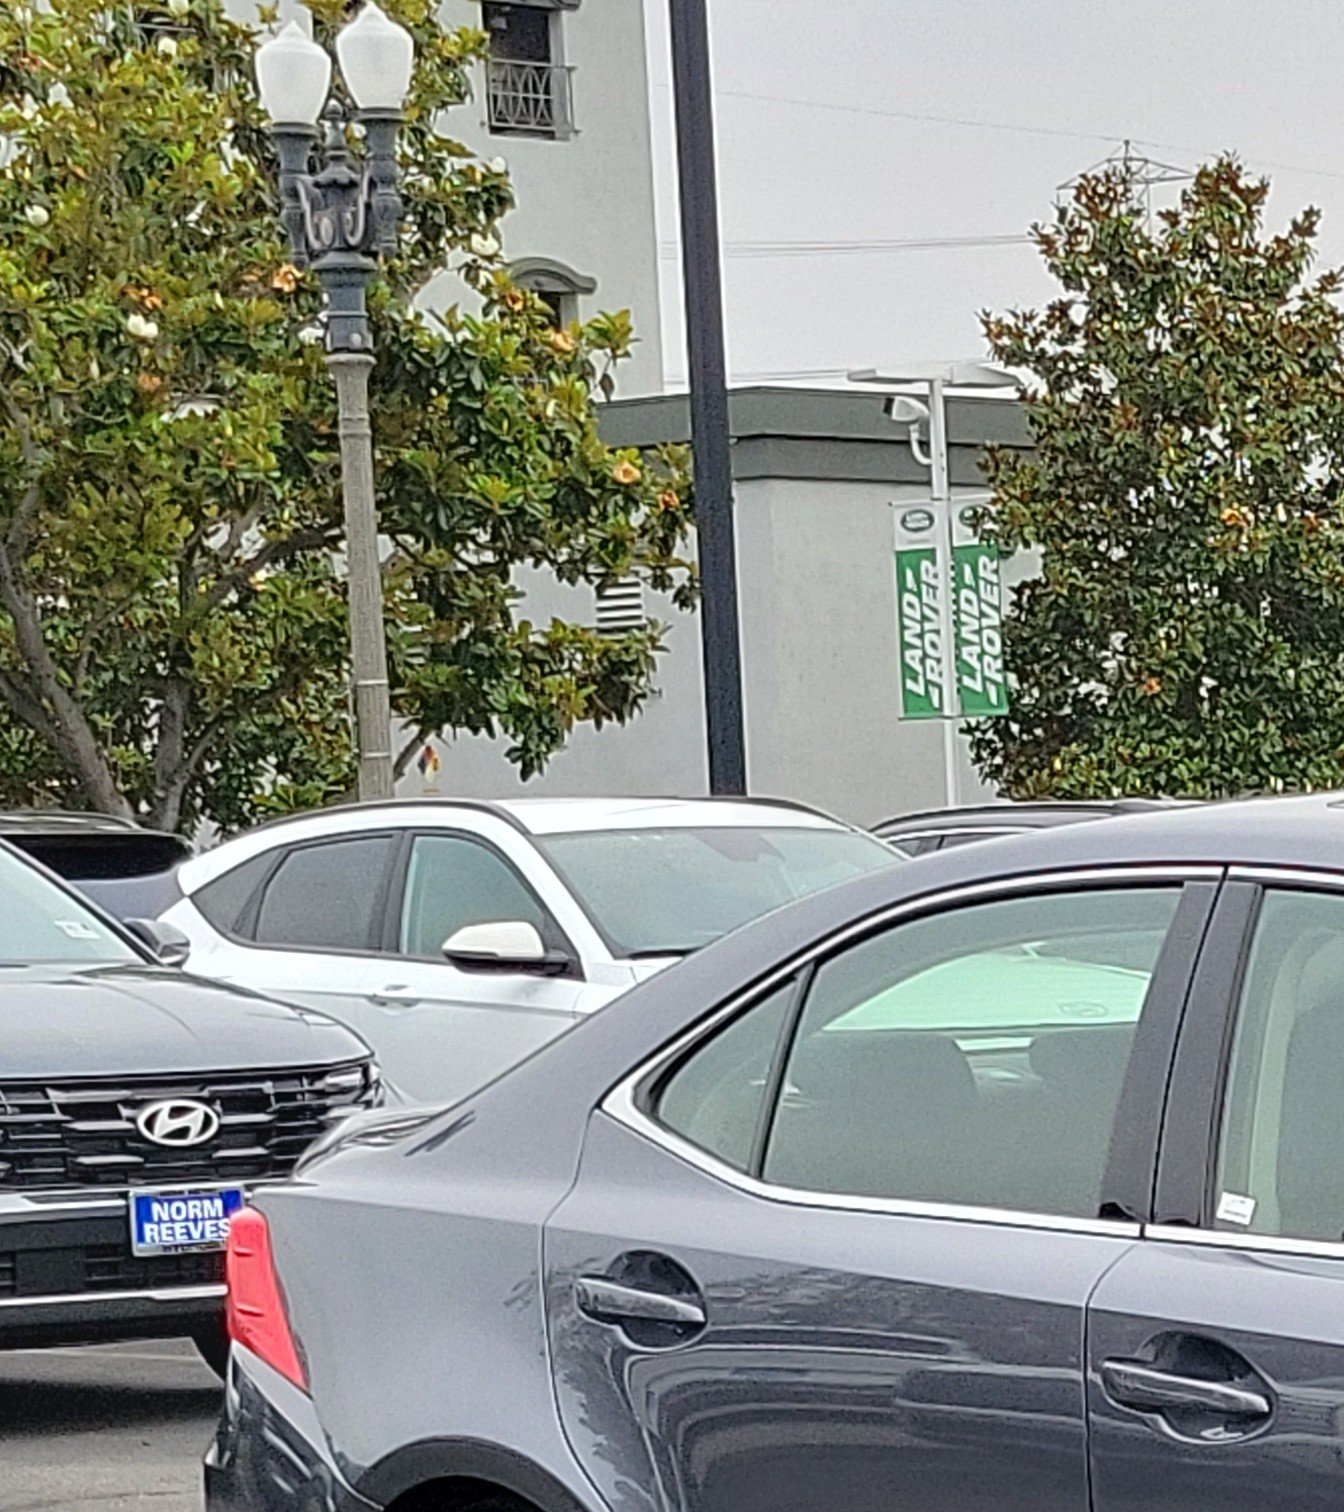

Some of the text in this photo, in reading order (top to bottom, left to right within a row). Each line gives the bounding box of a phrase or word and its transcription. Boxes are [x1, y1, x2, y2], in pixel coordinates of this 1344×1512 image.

[902, 591, 926, 697] LAND
[919, 559, 943, 686] ROVER
[959, 588, 984, 693] LAND
[977, 554, 1003, 684] ROVER
[143, 1217, 231, 1243] REEVES
[151, 1198, 223, 1222] NORM
